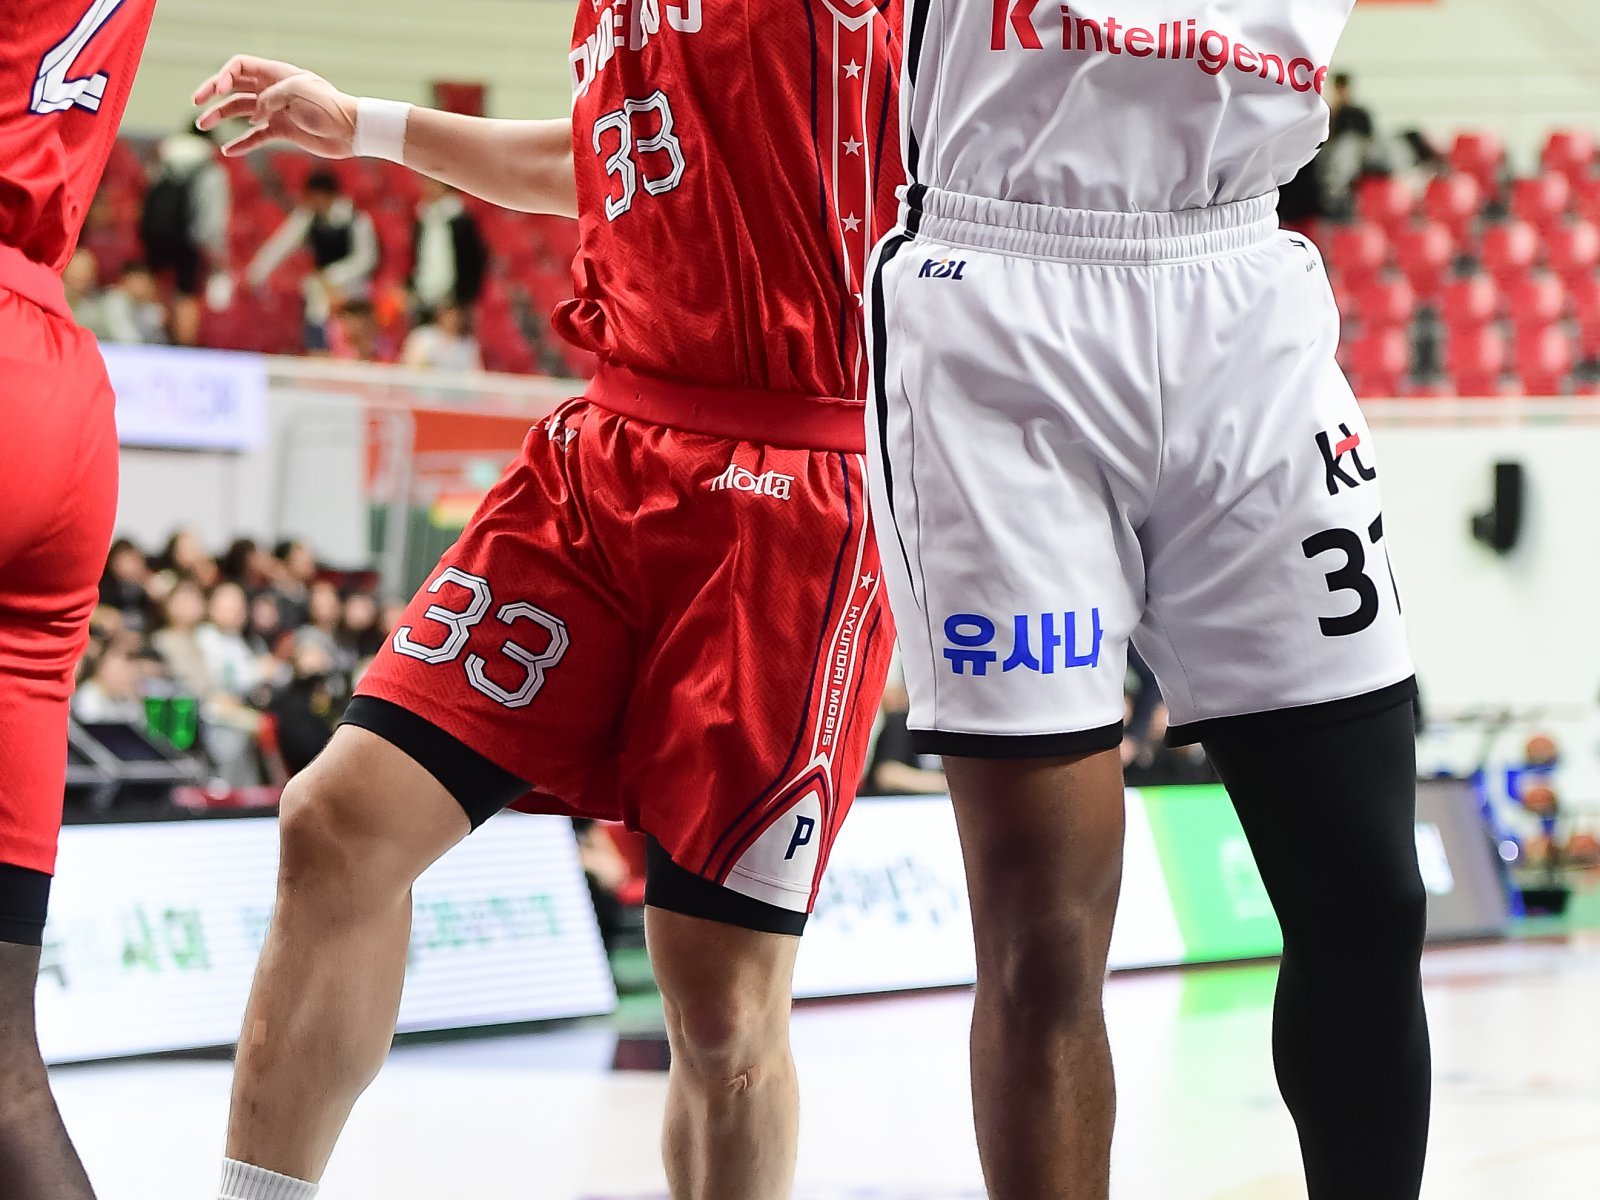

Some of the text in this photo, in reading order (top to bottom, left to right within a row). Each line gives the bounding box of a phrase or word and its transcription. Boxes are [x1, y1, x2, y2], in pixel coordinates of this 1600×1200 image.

[1060, 4, 1328, 96] intelligence
[592, 89, 687, 222] 33
[918, 258, 967, 280] KBL
[1315, 422, 1376, 496] kt
[392, 565, 570, 708] 33
[822, 605, 861, 747] HYUNDAI MOBIS
[943, 607, 1104, 676] 유사나
[784, 815, 815, 860] P
